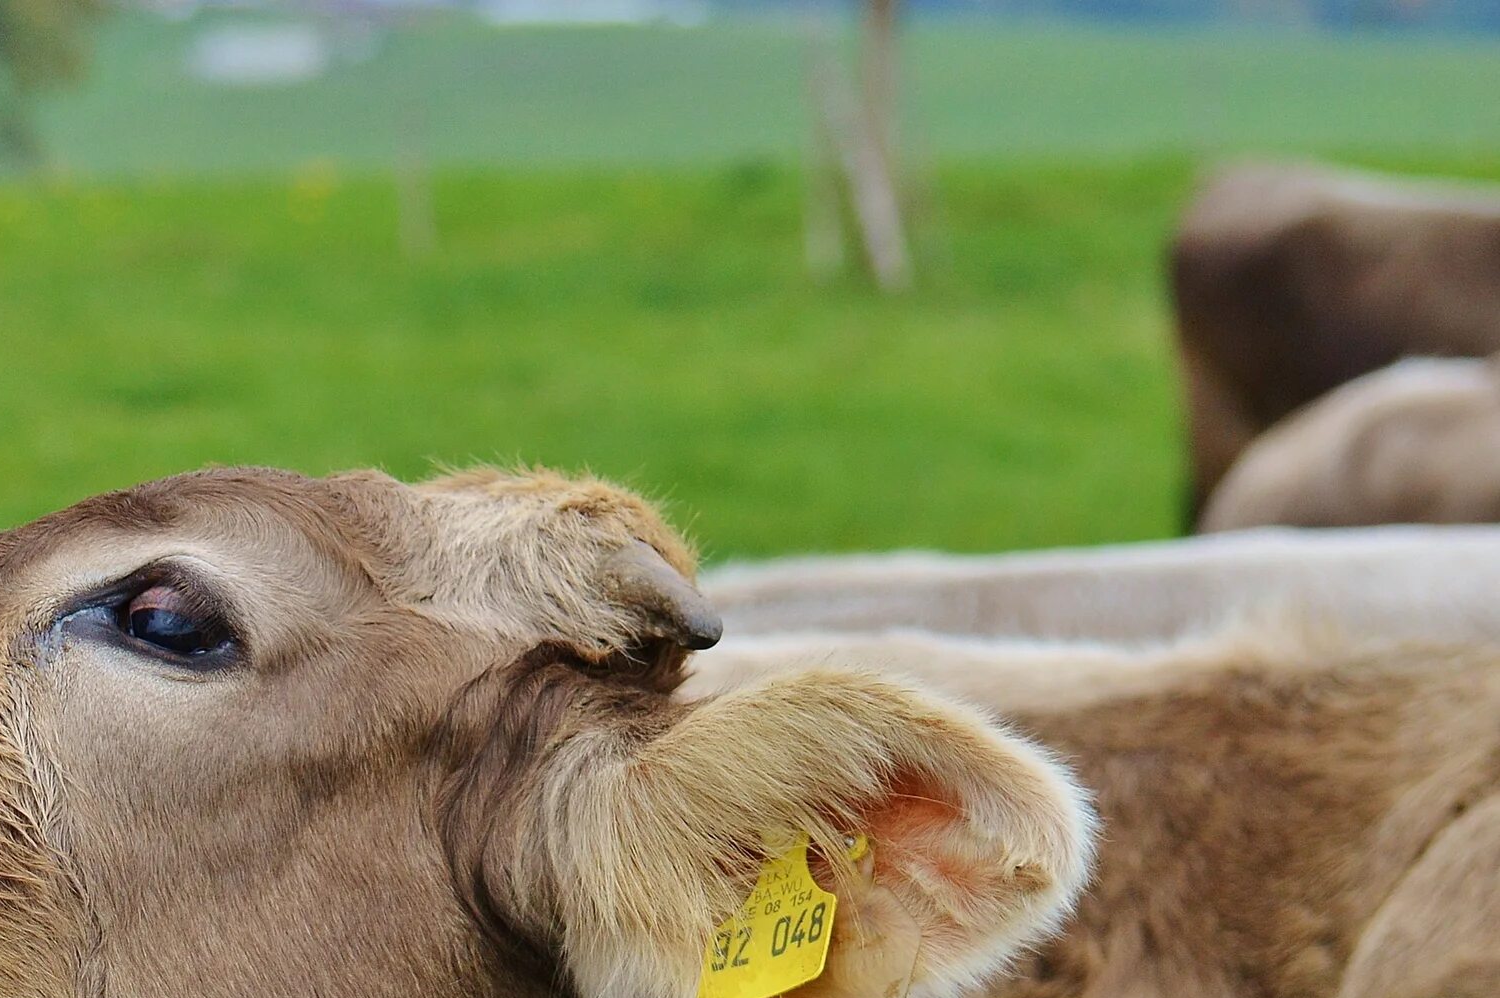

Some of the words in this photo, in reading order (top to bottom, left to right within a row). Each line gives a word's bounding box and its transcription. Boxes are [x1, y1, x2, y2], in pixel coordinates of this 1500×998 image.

[765, 900, 781, 915] 08
[790, 889, 812, 906] 154
[772, 902, 826, 957] 048
